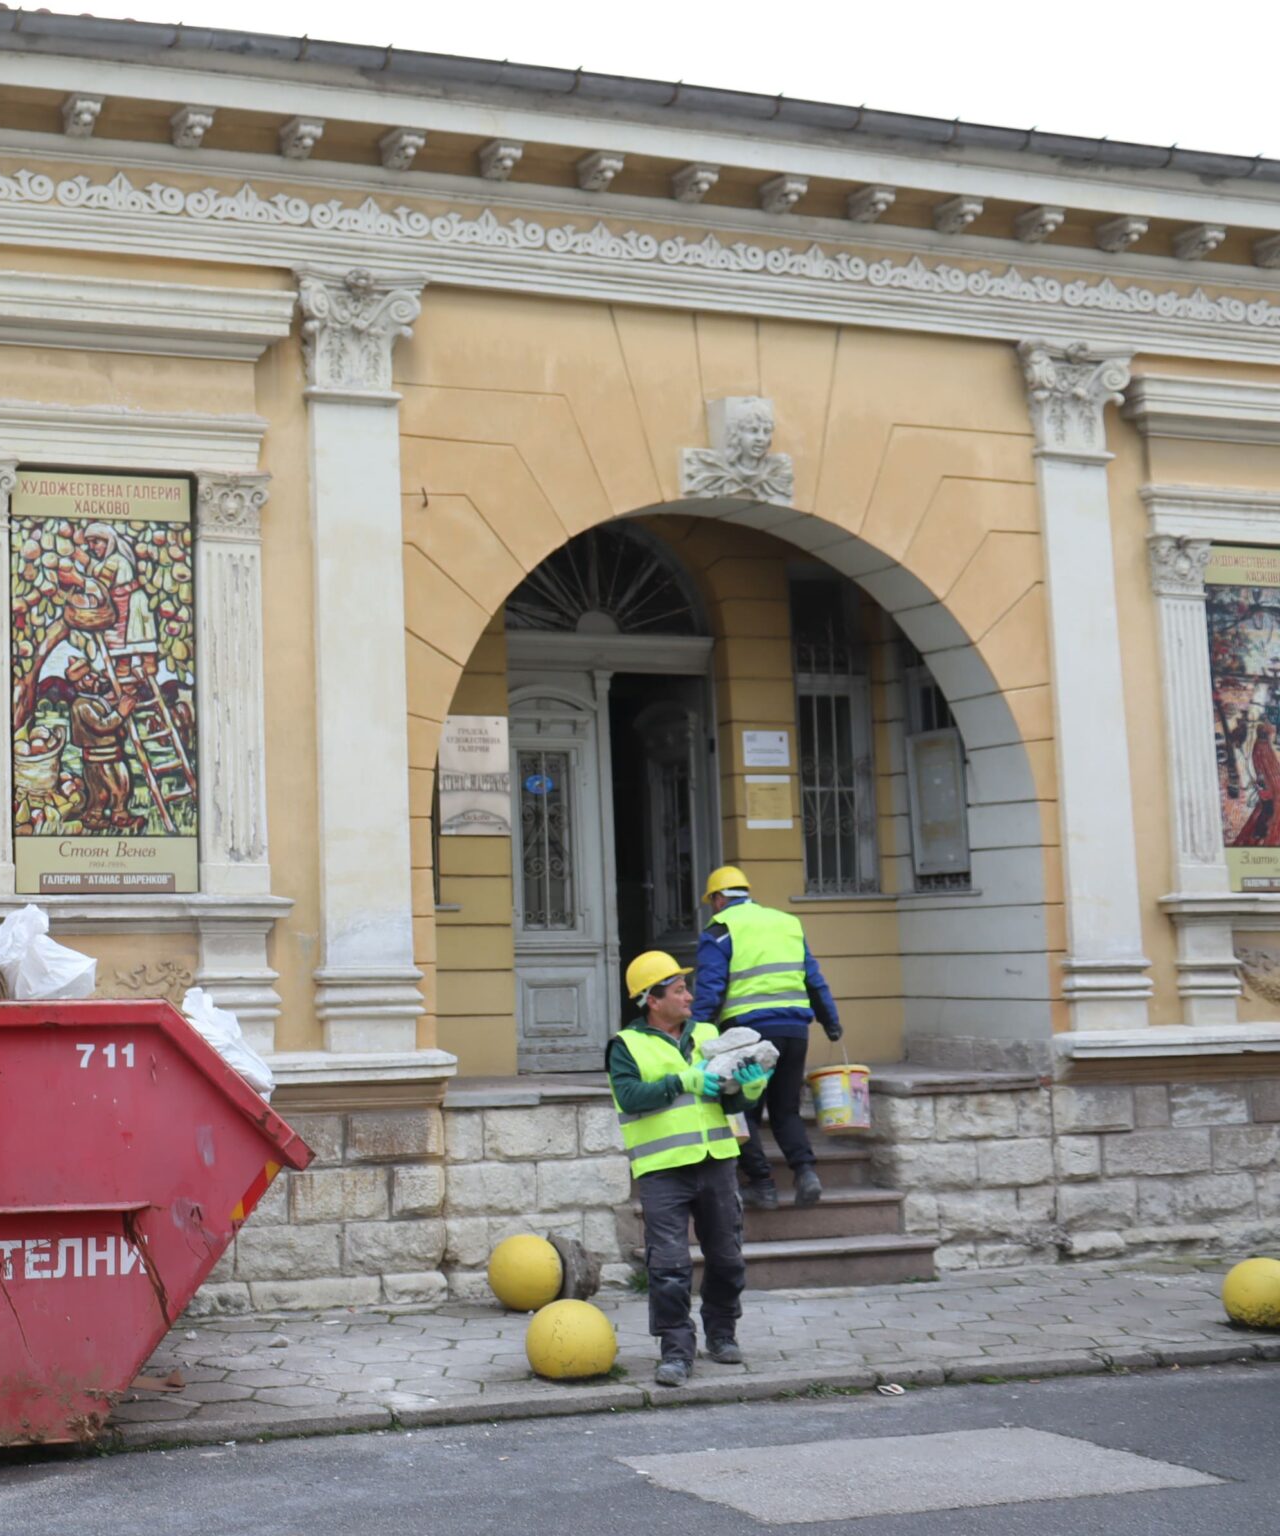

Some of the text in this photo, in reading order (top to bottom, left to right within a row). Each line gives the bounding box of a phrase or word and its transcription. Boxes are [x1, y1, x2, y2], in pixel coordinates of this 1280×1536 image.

[20, 480, 181, 500] ХУДОЖЕСТВЕНА ГАЛЕРИЯ
[74, 500, 130, 516] ХАСКОВО
[58, 841, 157, 858] Стоян Венев
[43, 875, 81, 885] ГАЛЕРИЯ
[123, 875, 172, 885] ШАРЕНКОВ"
